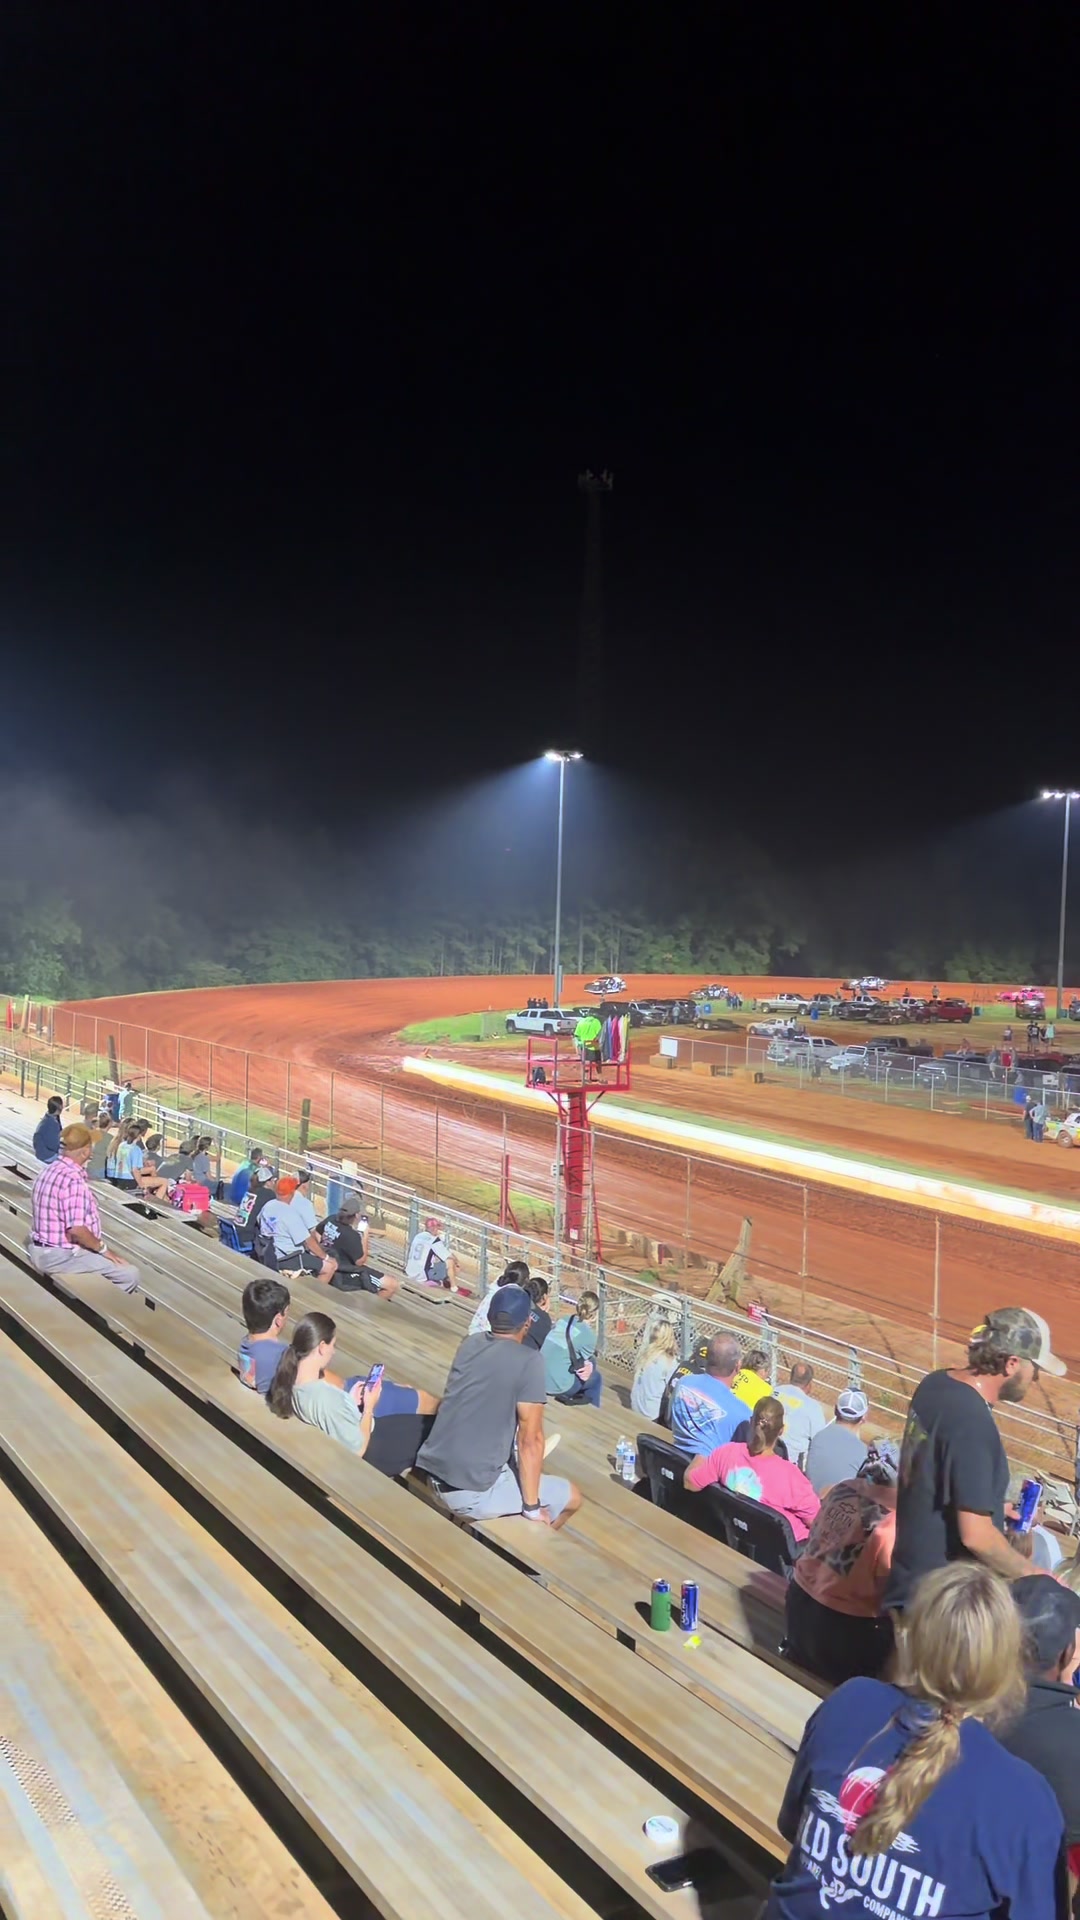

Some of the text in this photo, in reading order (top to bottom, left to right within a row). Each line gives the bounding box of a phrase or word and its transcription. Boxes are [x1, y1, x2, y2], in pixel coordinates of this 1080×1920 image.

[799, 1808, 946, 1918] LD SOUTH
[863, 1895, 912, 1920] COMPA
